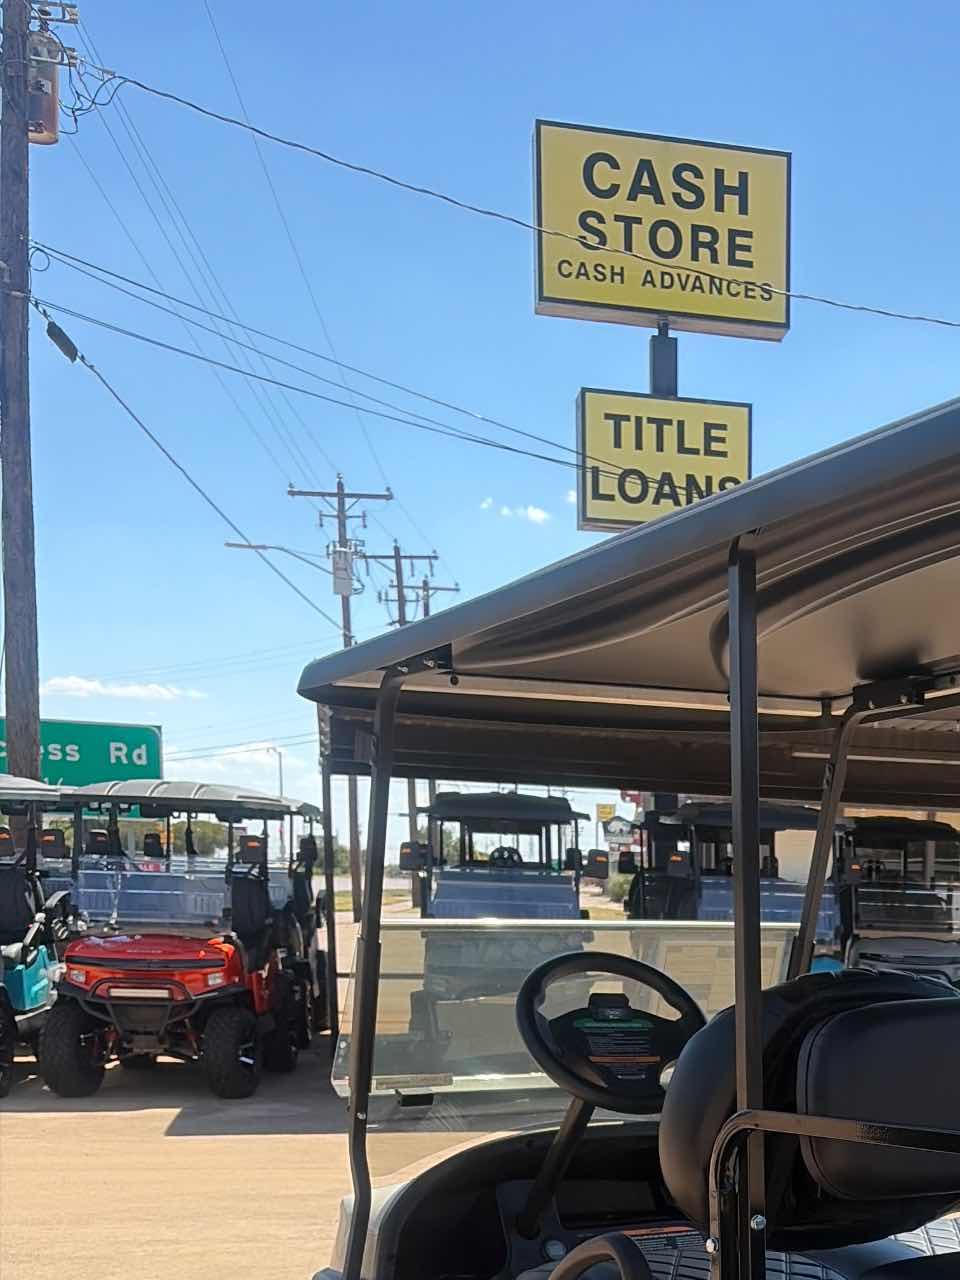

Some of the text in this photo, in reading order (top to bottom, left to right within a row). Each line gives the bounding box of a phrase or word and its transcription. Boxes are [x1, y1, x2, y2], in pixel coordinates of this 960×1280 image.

[582, 152, 749, 216] CASH
[577, 210, 755, 269] STORE
[557, 259, 774, 302] CASH ADVANCES
[603, 412, 729, 458] TITLE
[108, 741, 148, 766] Rd
